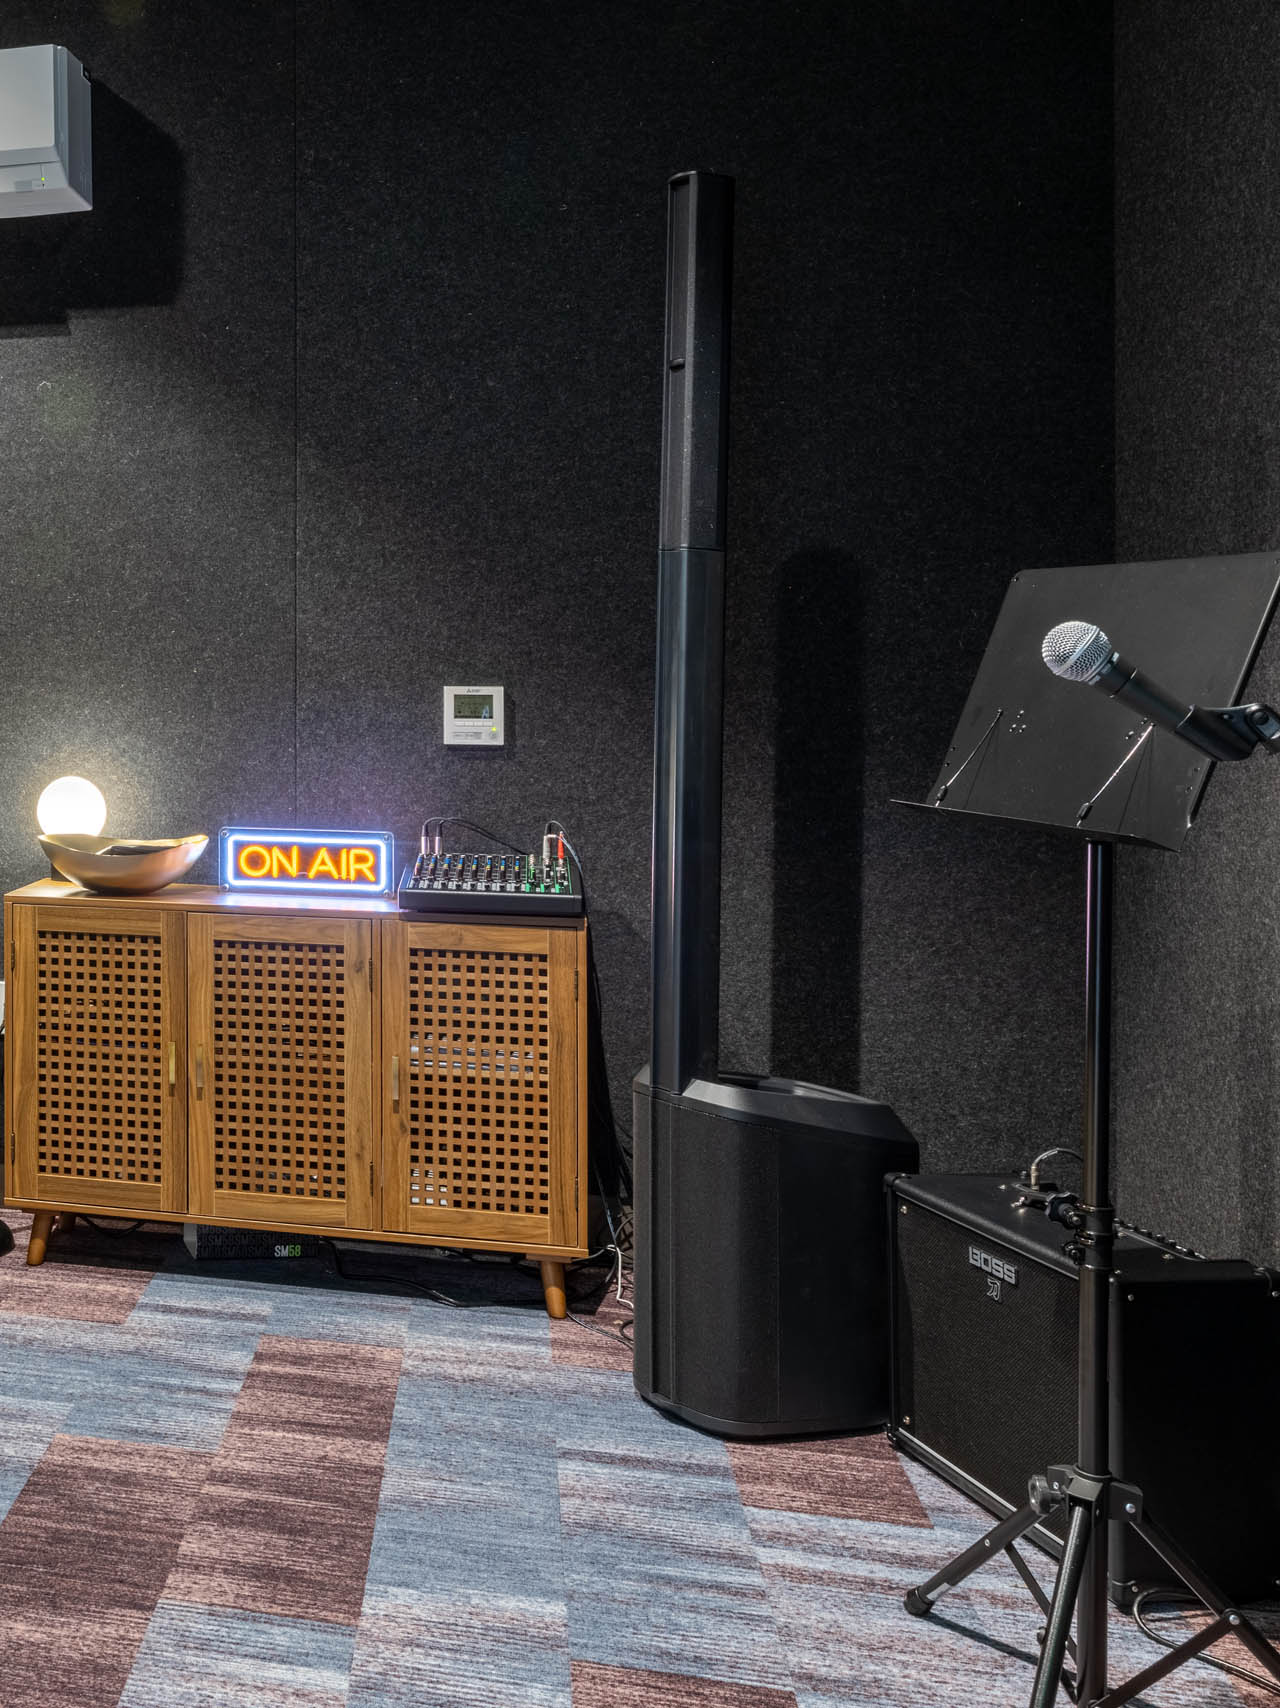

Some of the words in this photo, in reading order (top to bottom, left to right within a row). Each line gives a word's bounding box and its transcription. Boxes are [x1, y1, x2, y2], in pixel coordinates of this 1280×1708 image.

[239, 844, 298, 879] ON
[307, 846, 376, 883] AIR
[274, 1244, 301, 1257] SM58
[968, 1246, 1016, 1285] BOSS
